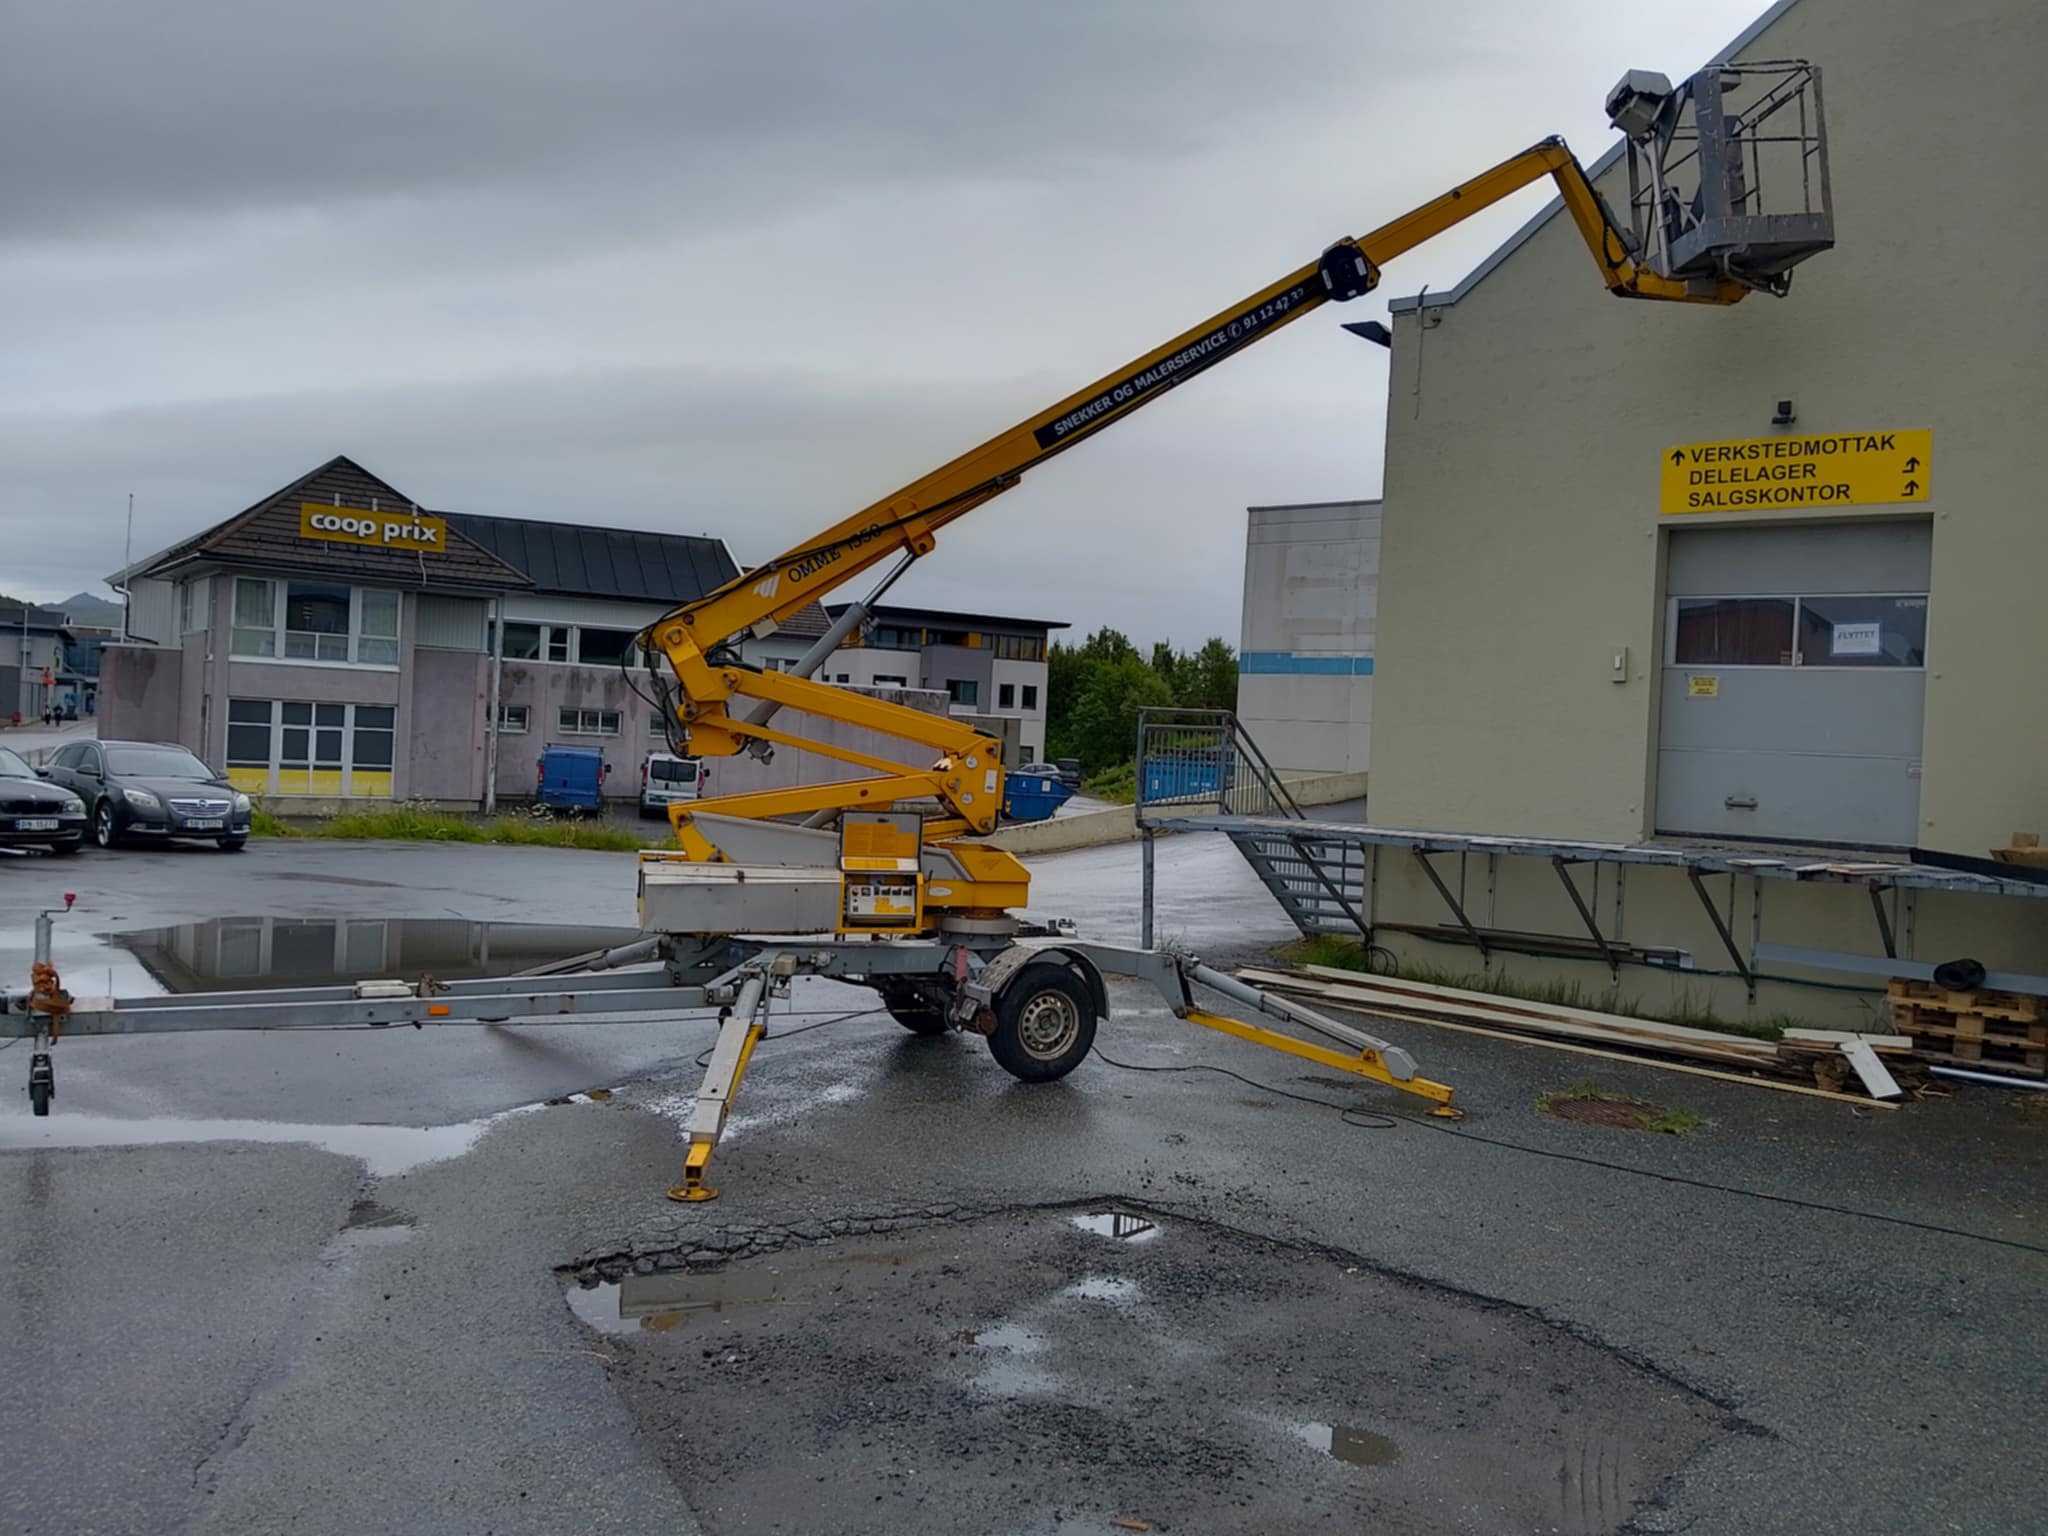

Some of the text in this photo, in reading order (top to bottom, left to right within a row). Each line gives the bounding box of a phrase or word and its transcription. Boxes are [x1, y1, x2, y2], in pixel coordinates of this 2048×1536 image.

[1053, 396, 1112, 436] SNEKKER
[1113, 384, 1134, 402] OG
[1135, 331, 1228, 391] MALERSERVICE
[1242, 314, 1258, 329] 91
[1259, 305, 1274, 320] 12
[1690, 434, 1896, 463] VERKSTEDMOTTAK
[1689, 463, 1816, 485] DELELAGER
[1688, 484, 1850, 507] SALGSKONTOR
[310, 514, 437, 543] coop prix
[788, 548, 842, 582] OMME
